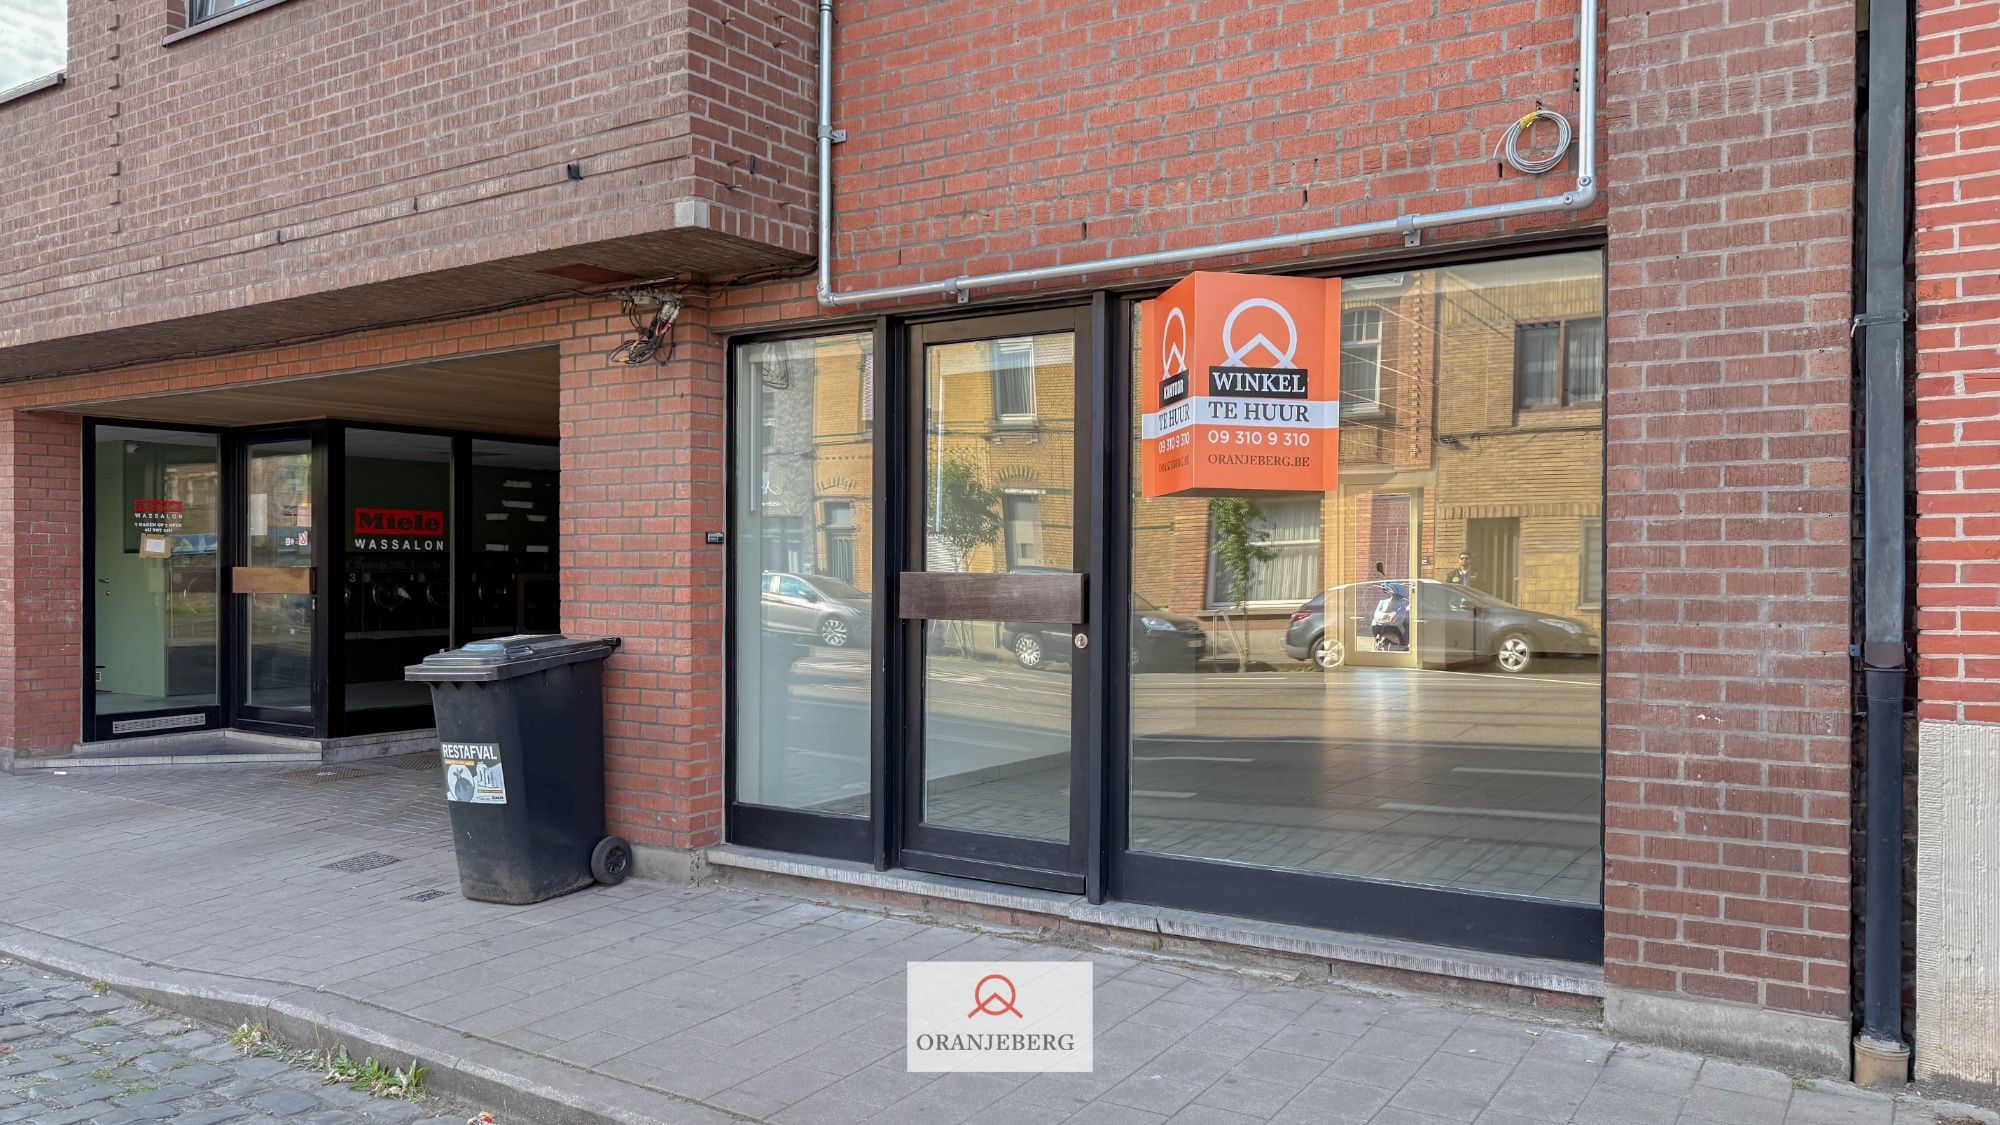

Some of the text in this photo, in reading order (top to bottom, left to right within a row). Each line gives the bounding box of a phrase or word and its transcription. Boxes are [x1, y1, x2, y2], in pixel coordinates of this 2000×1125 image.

[1212, 371, 1306, 393] WINKEL
[1159, 404, 1190, 431] TE HUUR
[1208, 401, 1310, 422] TE HUUR
[1159, 441, 1166, 454] 09
[1166, 437, 1175, 452] 310
[1181, 431, 1190, 447] 310
[1208, 429, 1310, 447] 09 310 9 310
[1208, 453, 1310, 468] ORANJEBERG.BE
[360, 513, 440, 530] Miele
[354, 539, 444, 551] WASSALON
[349, 573, 357, 583] 3
[442, 744, 498, 760] RESTAFVAL
